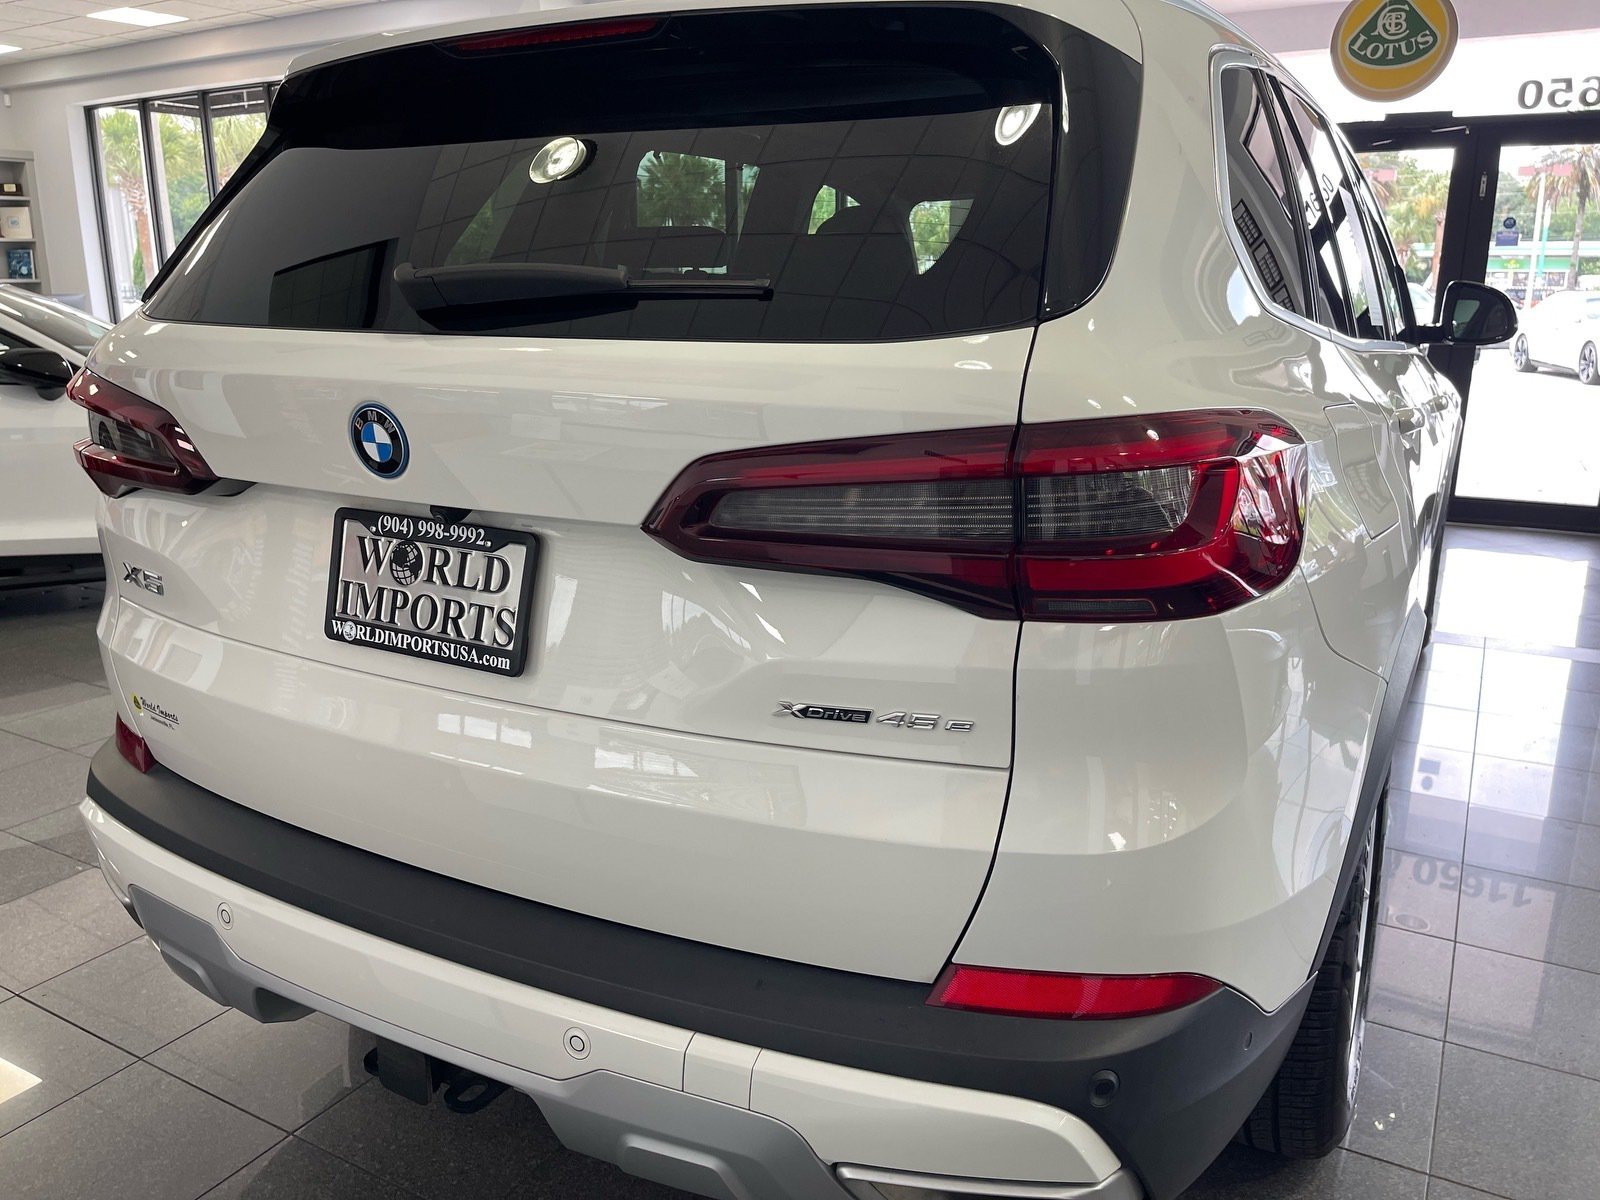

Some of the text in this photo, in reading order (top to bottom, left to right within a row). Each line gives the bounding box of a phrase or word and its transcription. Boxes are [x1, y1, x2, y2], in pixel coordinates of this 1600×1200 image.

[1351, 30, 1434, 59] LOTUS
[355, 410, 396, 434] BMW
[377, 515, 486, 546] (904) 998-9992
[122, 561, 165, 597] X5
[357, 535, 511, 594] WORLD
[339, 580, 516, 648] IMPORTS
[331, 620, 511, 670] WORLDIMPORTSUSA.com
